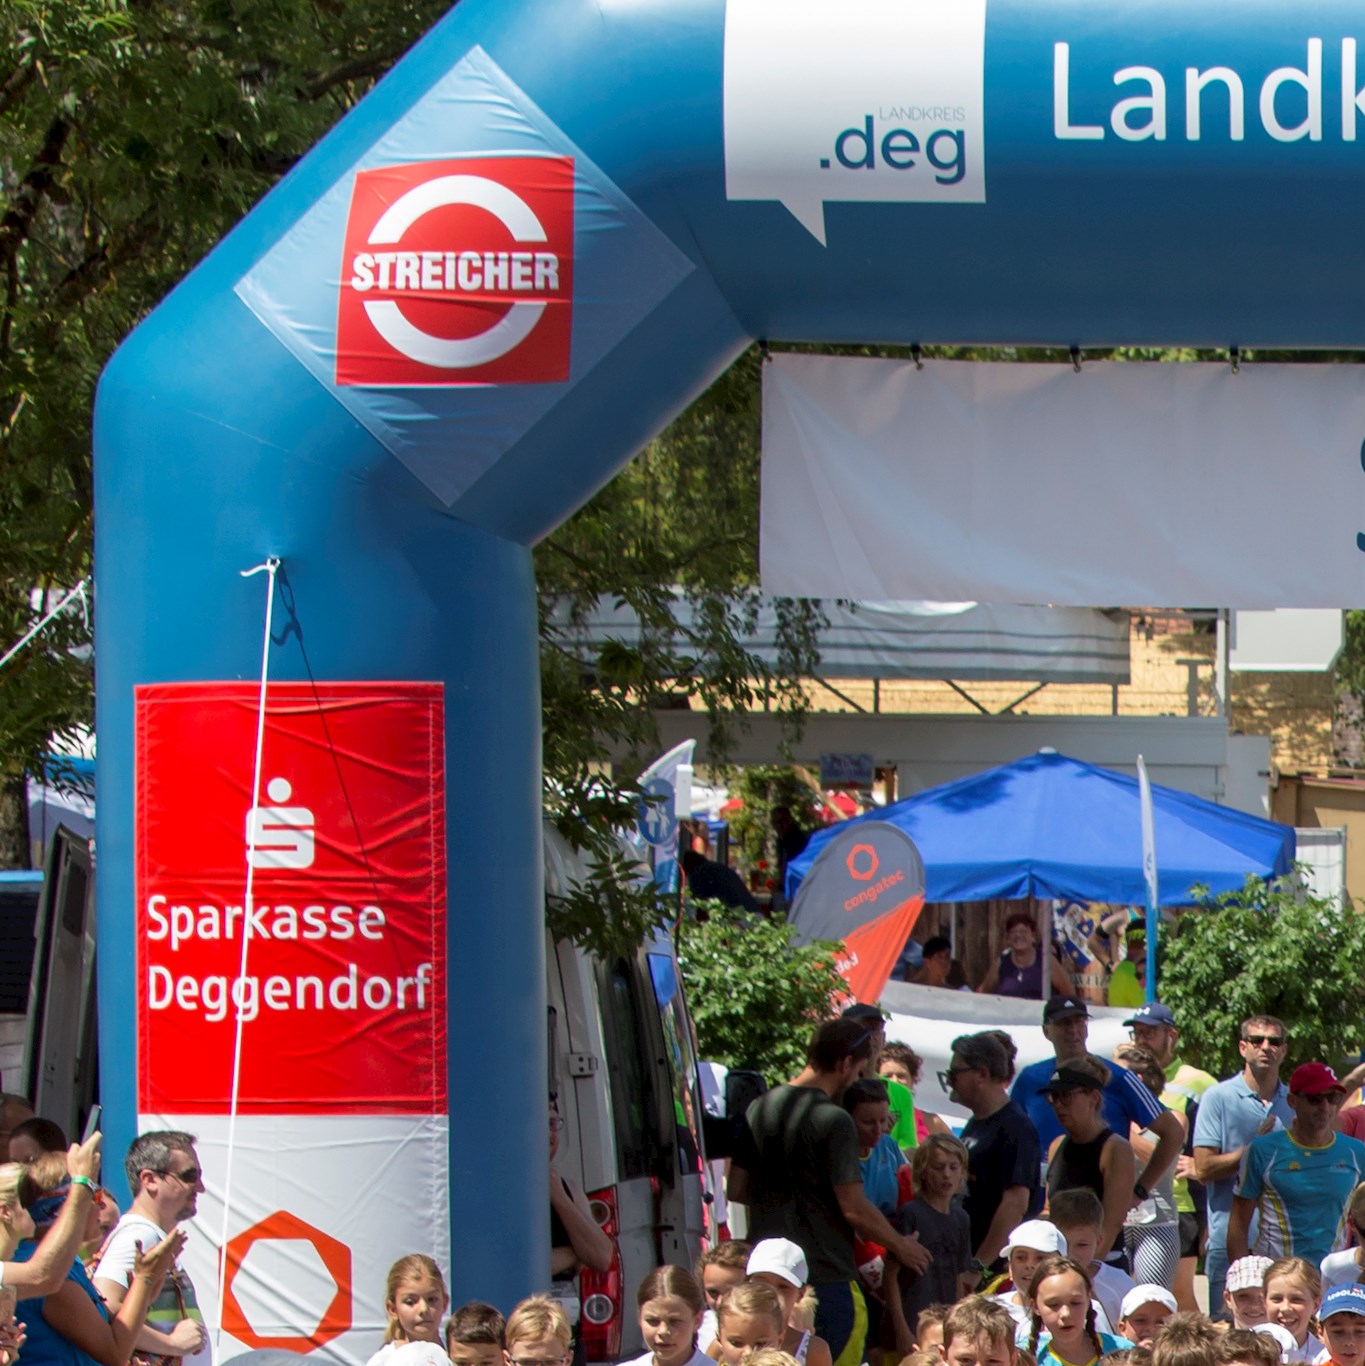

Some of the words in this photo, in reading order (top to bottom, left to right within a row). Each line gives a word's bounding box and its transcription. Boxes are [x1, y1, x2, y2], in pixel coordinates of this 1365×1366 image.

[879, 106, 966, 121] LANDKREIS
[819, 114, 966, 185] .deg
[351, 251, 561, 292] STREICHER
[844, 870, 904, 911] congatec
[147, 896, 386, 949] Sparkasse
[147, 964, 432, 1022] Deggendorf
